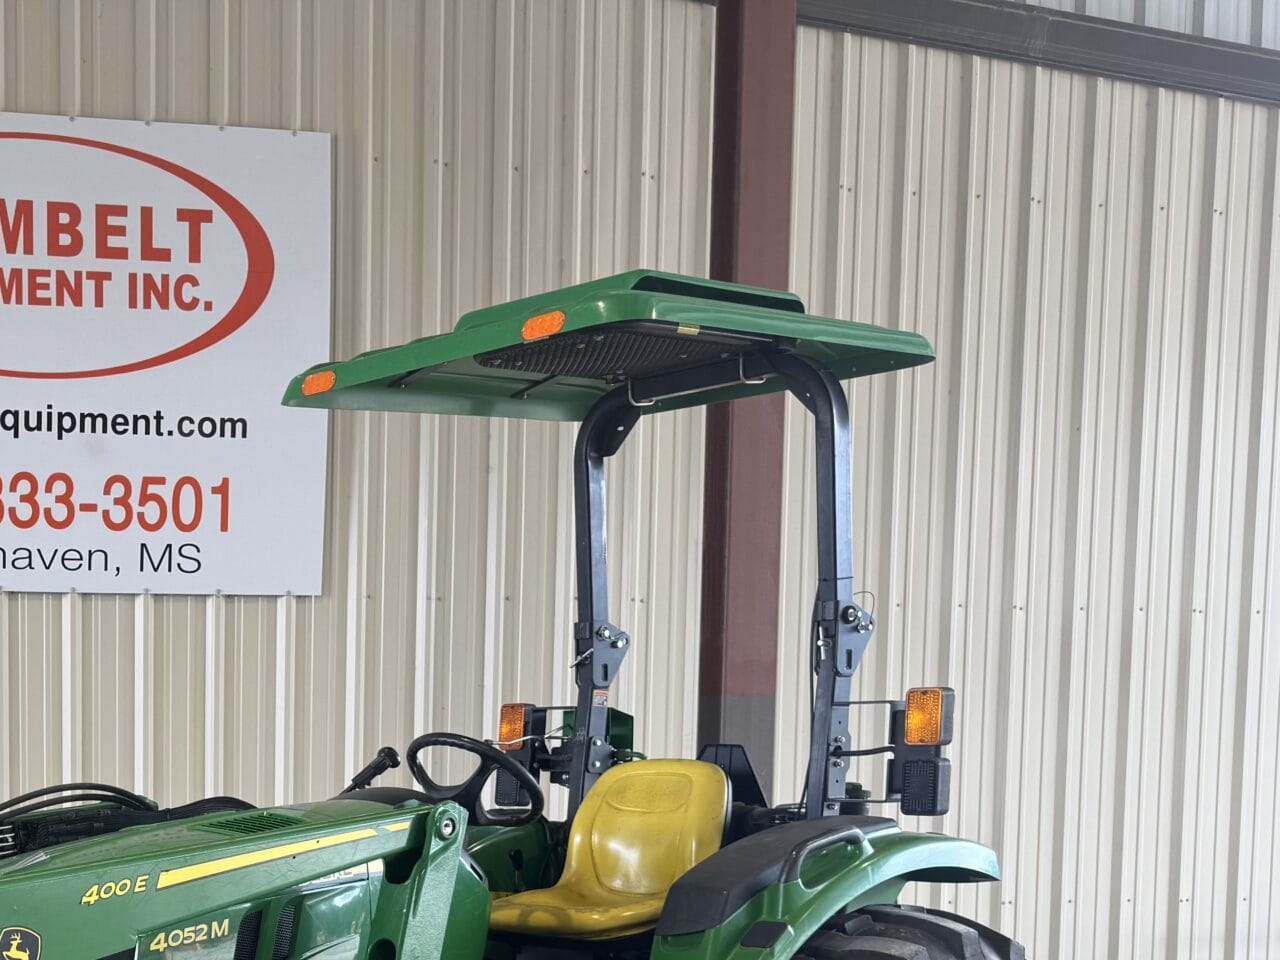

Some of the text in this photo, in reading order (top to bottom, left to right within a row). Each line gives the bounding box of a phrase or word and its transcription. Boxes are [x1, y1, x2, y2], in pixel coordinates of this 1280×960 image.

[127, 271, 214, 312] INC.
[139, 543, 203, 575] MS
[80, 874, 150, 905] 400 E
[149, 918, 230, 953] 4052 M
